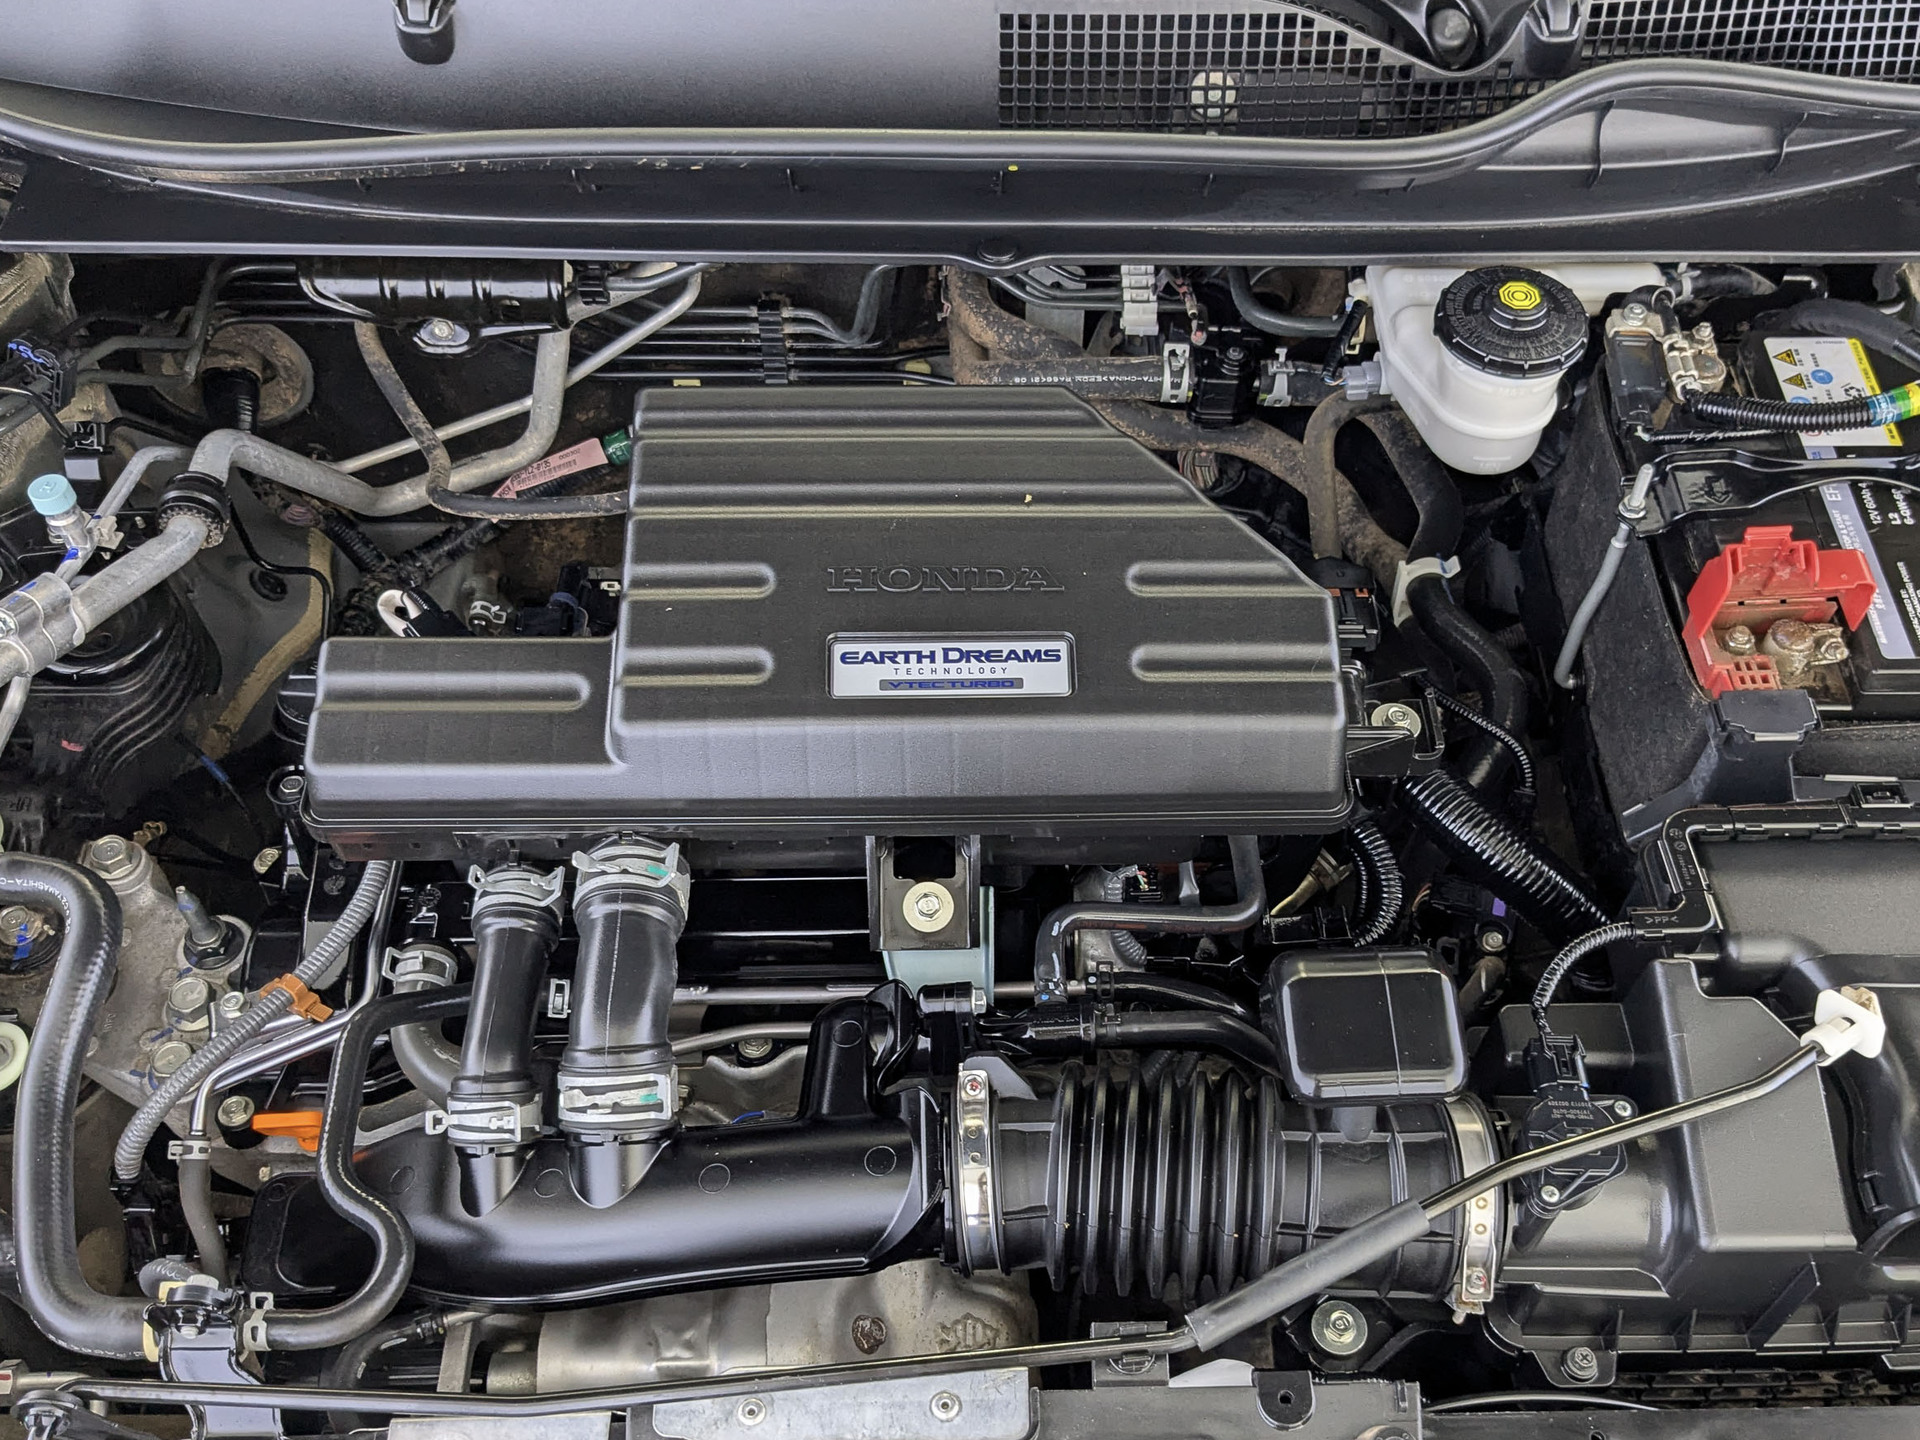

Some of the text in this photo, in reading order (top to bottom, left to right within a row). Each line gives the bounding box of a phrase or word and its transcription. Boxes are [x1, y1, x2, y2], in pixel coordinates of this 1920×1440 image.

[1824, 484, 1842, 501] EF
[1868, 509, 1882, 525] 12V
[1888, 513, 1902, 525] L2
[827, 564, 1065, 593] HONDA
[840, 647, 1062, 665] EARTH DREAMS
[893, 667, 1008, 676] TECHNOLOGY
[888, 680, 1015, 689] VTEC TURBO
